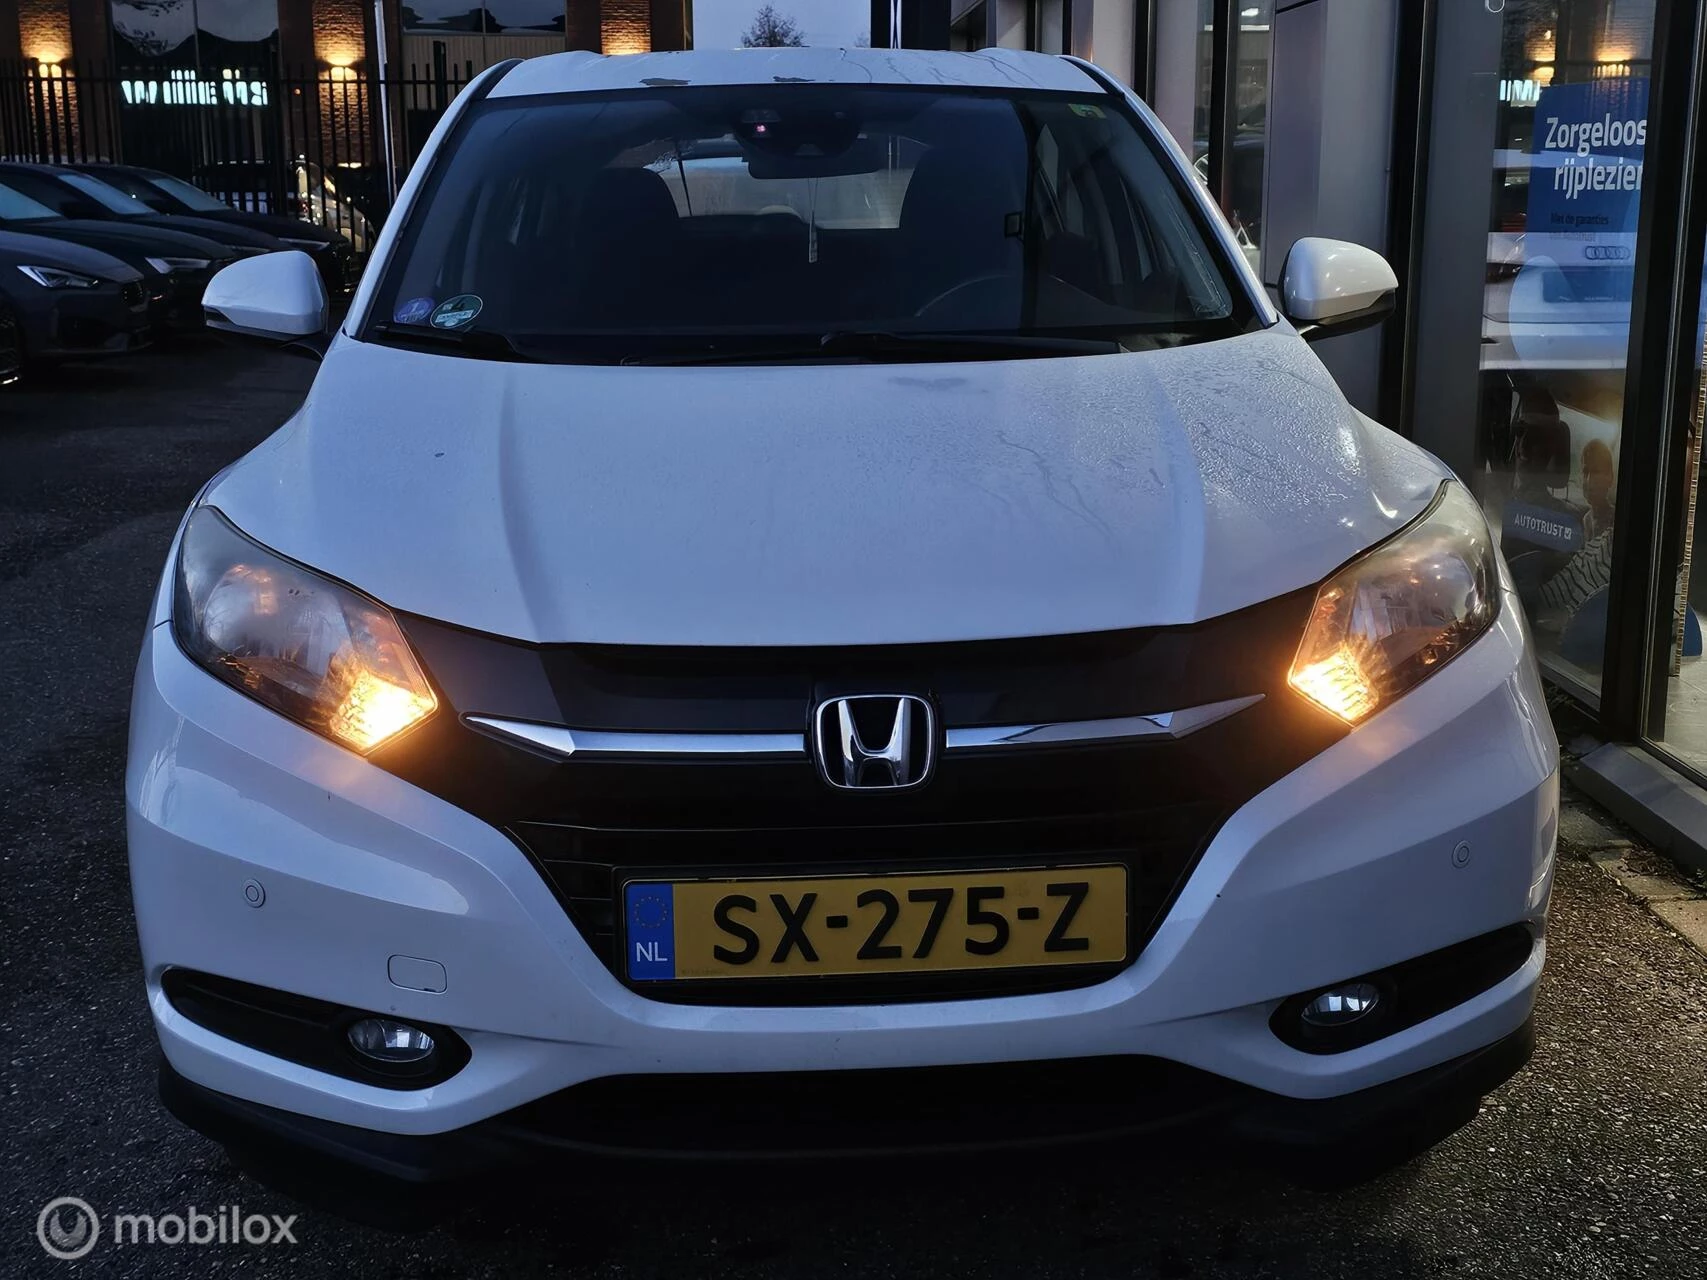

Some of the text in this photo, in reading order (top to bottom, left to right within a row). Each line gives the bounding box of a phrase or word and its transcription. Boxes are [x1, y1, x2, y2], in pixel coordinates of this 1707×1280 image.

[1544, 113, 1648, 157] Zorgeloos
[1514, 513, 1564, 537] AUTOTRUST
[713, 882, 1090, 965] SX-275-Z
[636, 942, 668, 962] NL
